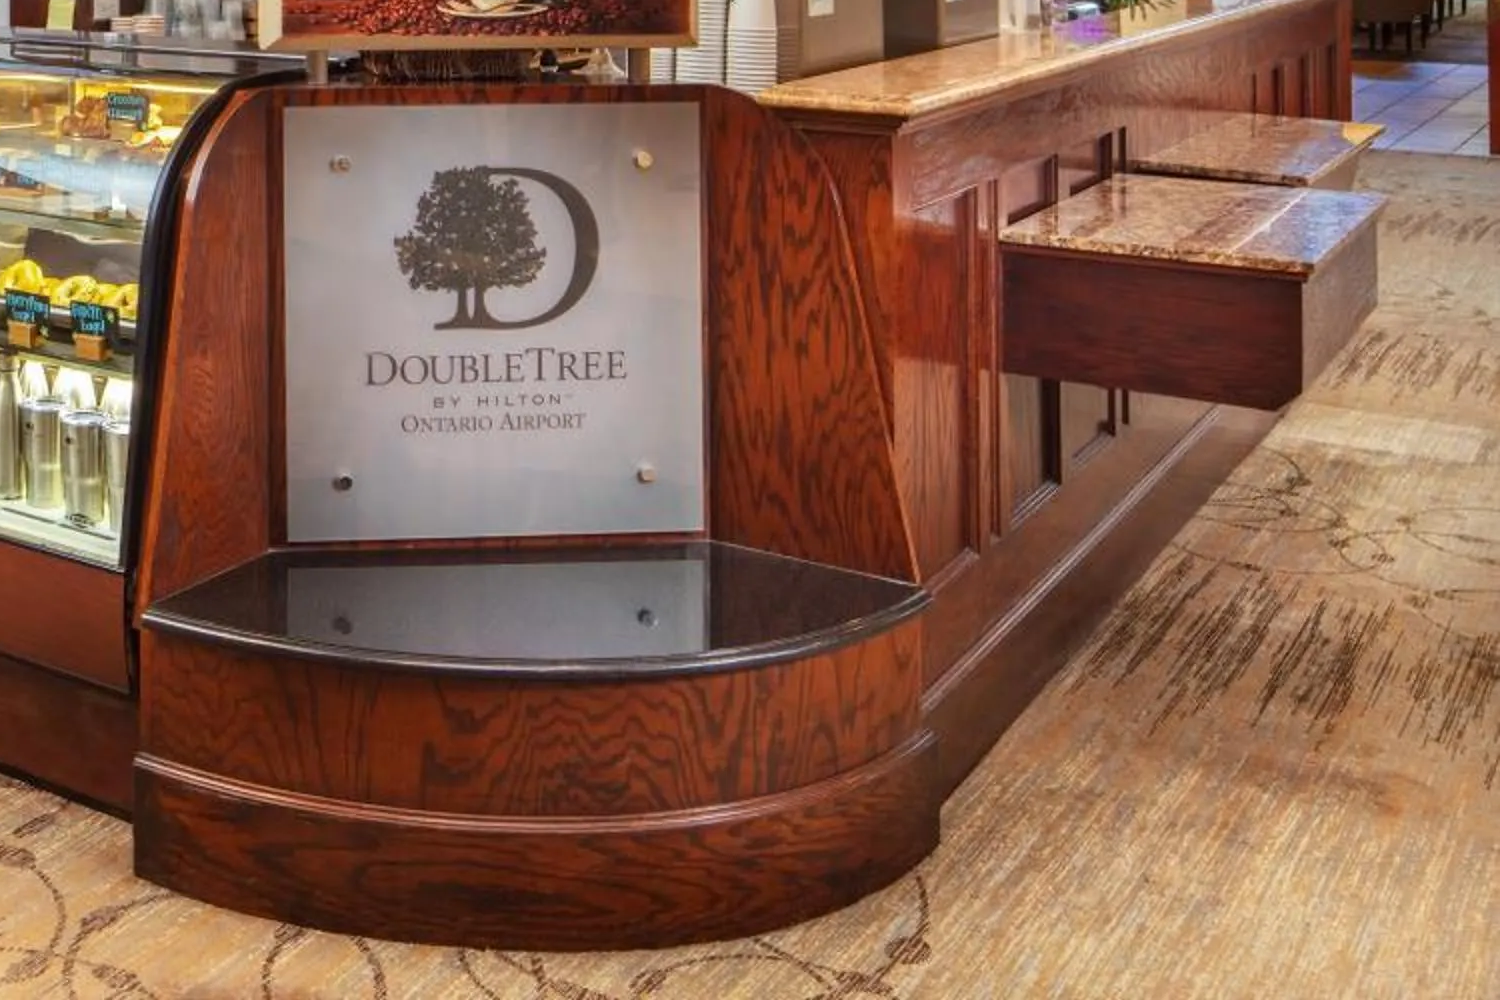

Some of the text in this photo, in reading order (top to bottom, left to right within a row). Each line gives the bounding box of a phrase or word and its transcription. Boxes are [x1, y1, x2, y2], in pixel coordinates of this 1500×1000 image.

[365, 347, 628, 386] DOUBLETREE
[432, 394, 562, 409] BY HILTON
[401, 412, 587, 434] ONTARIO AIRPORT
